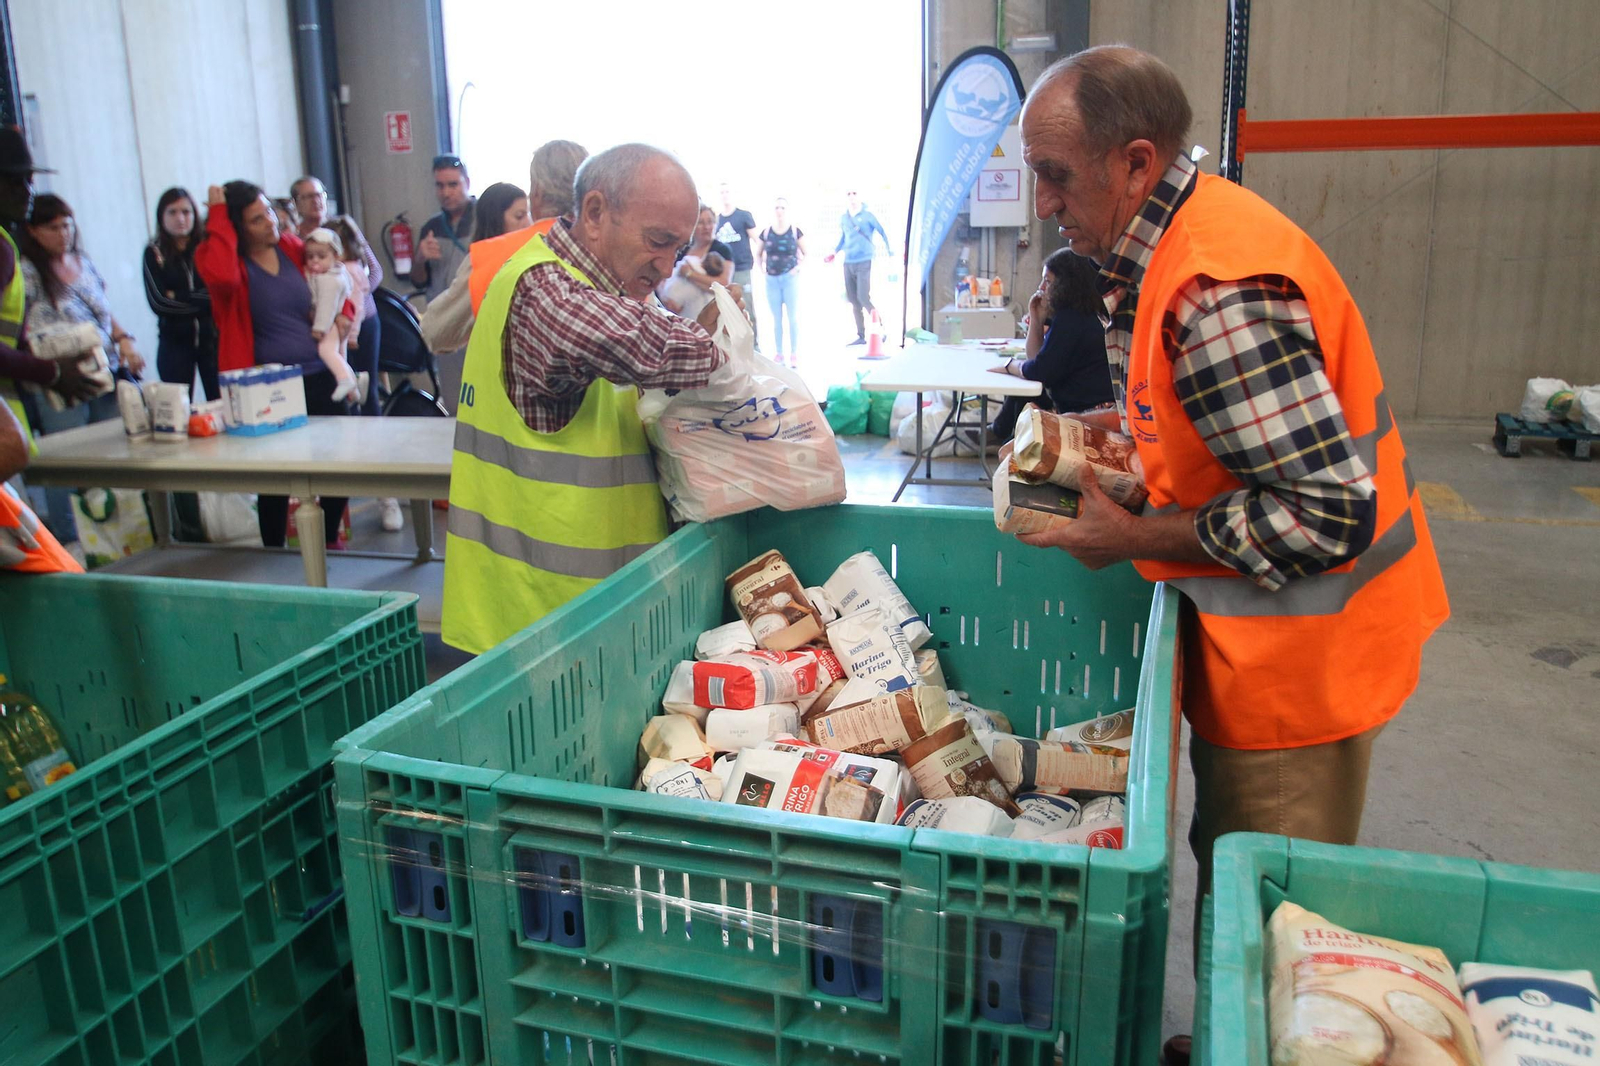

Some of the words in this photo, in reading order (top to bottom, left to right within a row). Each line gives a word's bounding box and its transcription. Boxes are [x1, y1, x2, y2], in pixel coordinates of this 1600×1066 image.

[949, 142, 971, 175] falta
[961, 142, 987, 182] sobra
[736, 577, 765, 598] Integral
[851, 651, 886, 673] Harina
[866, 659, 892, 675] Trigo
[943, 748, 971, 768] Integral
[1303, 939, 1323, 948] de
